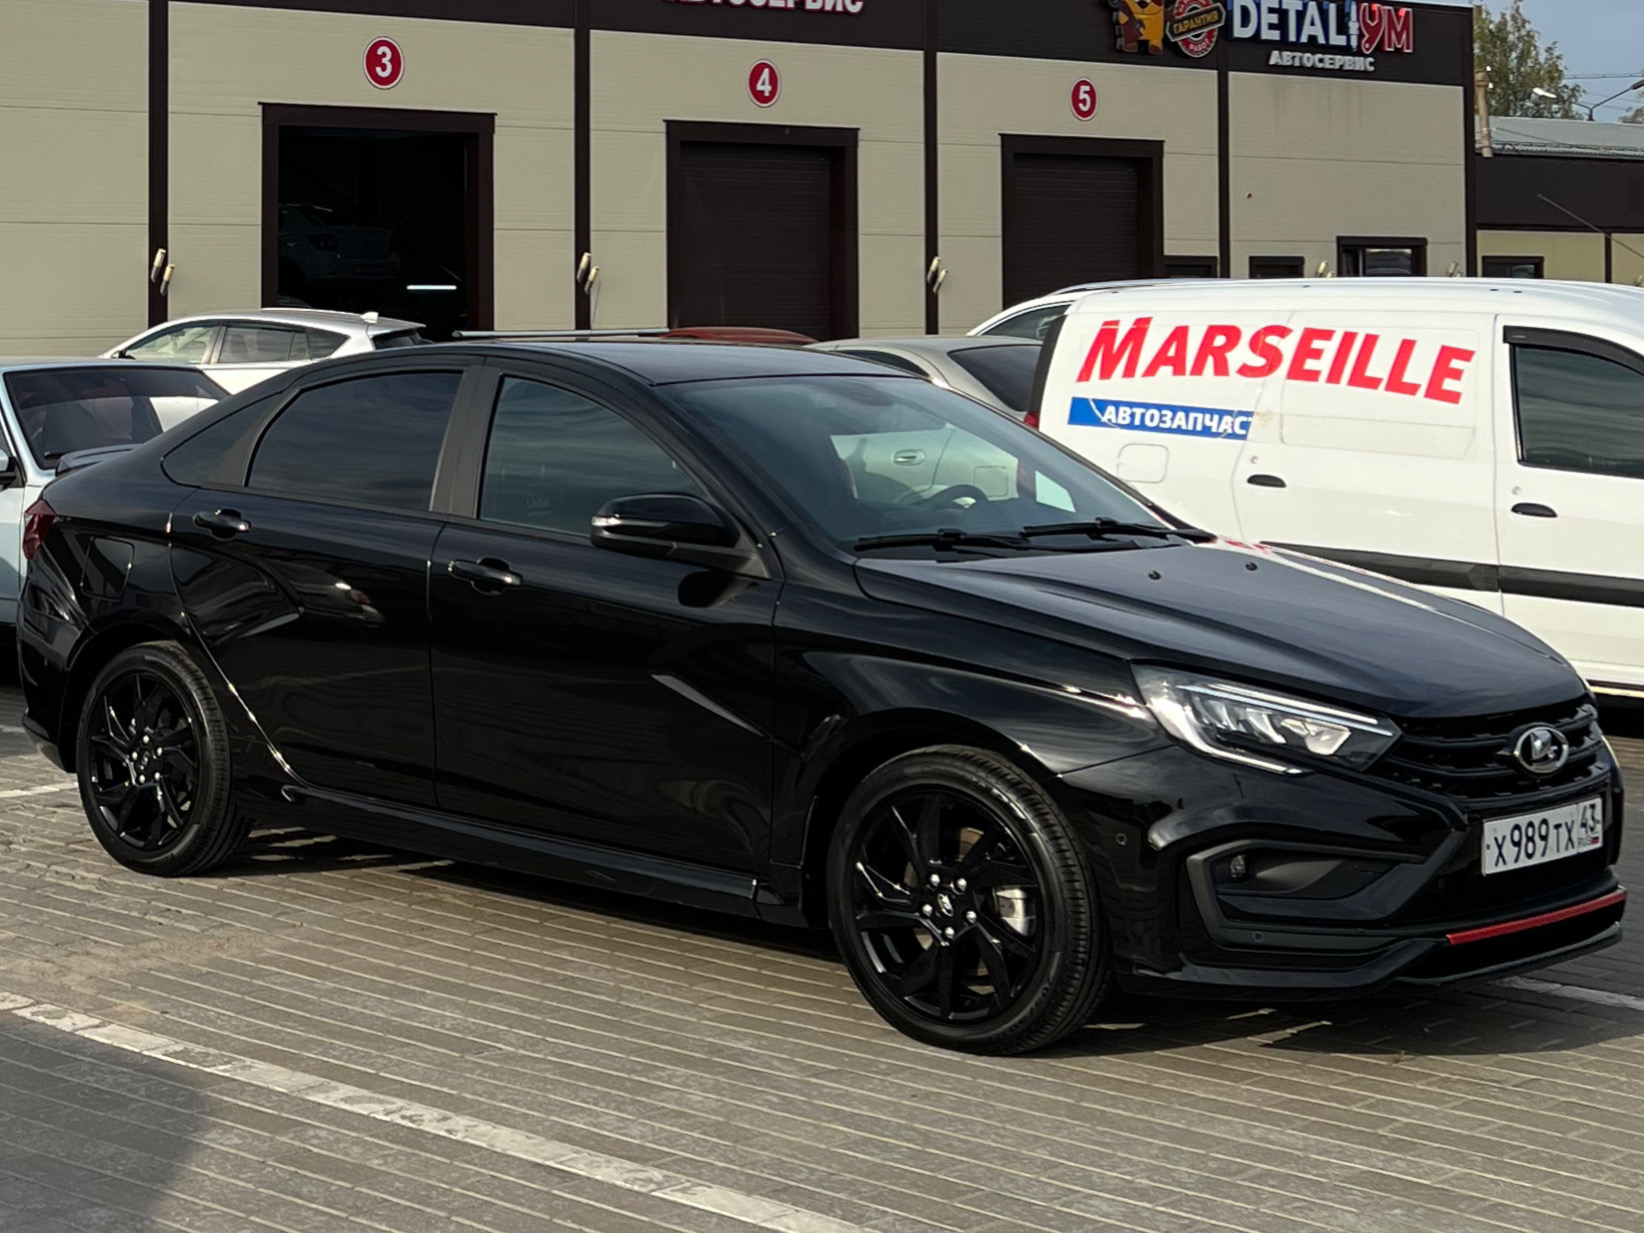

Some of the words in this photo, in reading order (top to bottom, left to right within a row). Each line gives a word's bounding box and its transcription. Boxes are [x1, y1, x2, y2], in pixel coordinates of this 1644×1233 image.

[375, 45, 393, 78] 3
[1268, 50, 1376, 72] АВТОСЕРВИС
[755, 67, 773, 97] 4
[1078, 85, 1092, 112] 5
[1076, 316, 1476, 405] MARSEILLE
[1579, 803, 1597, 834] 43
